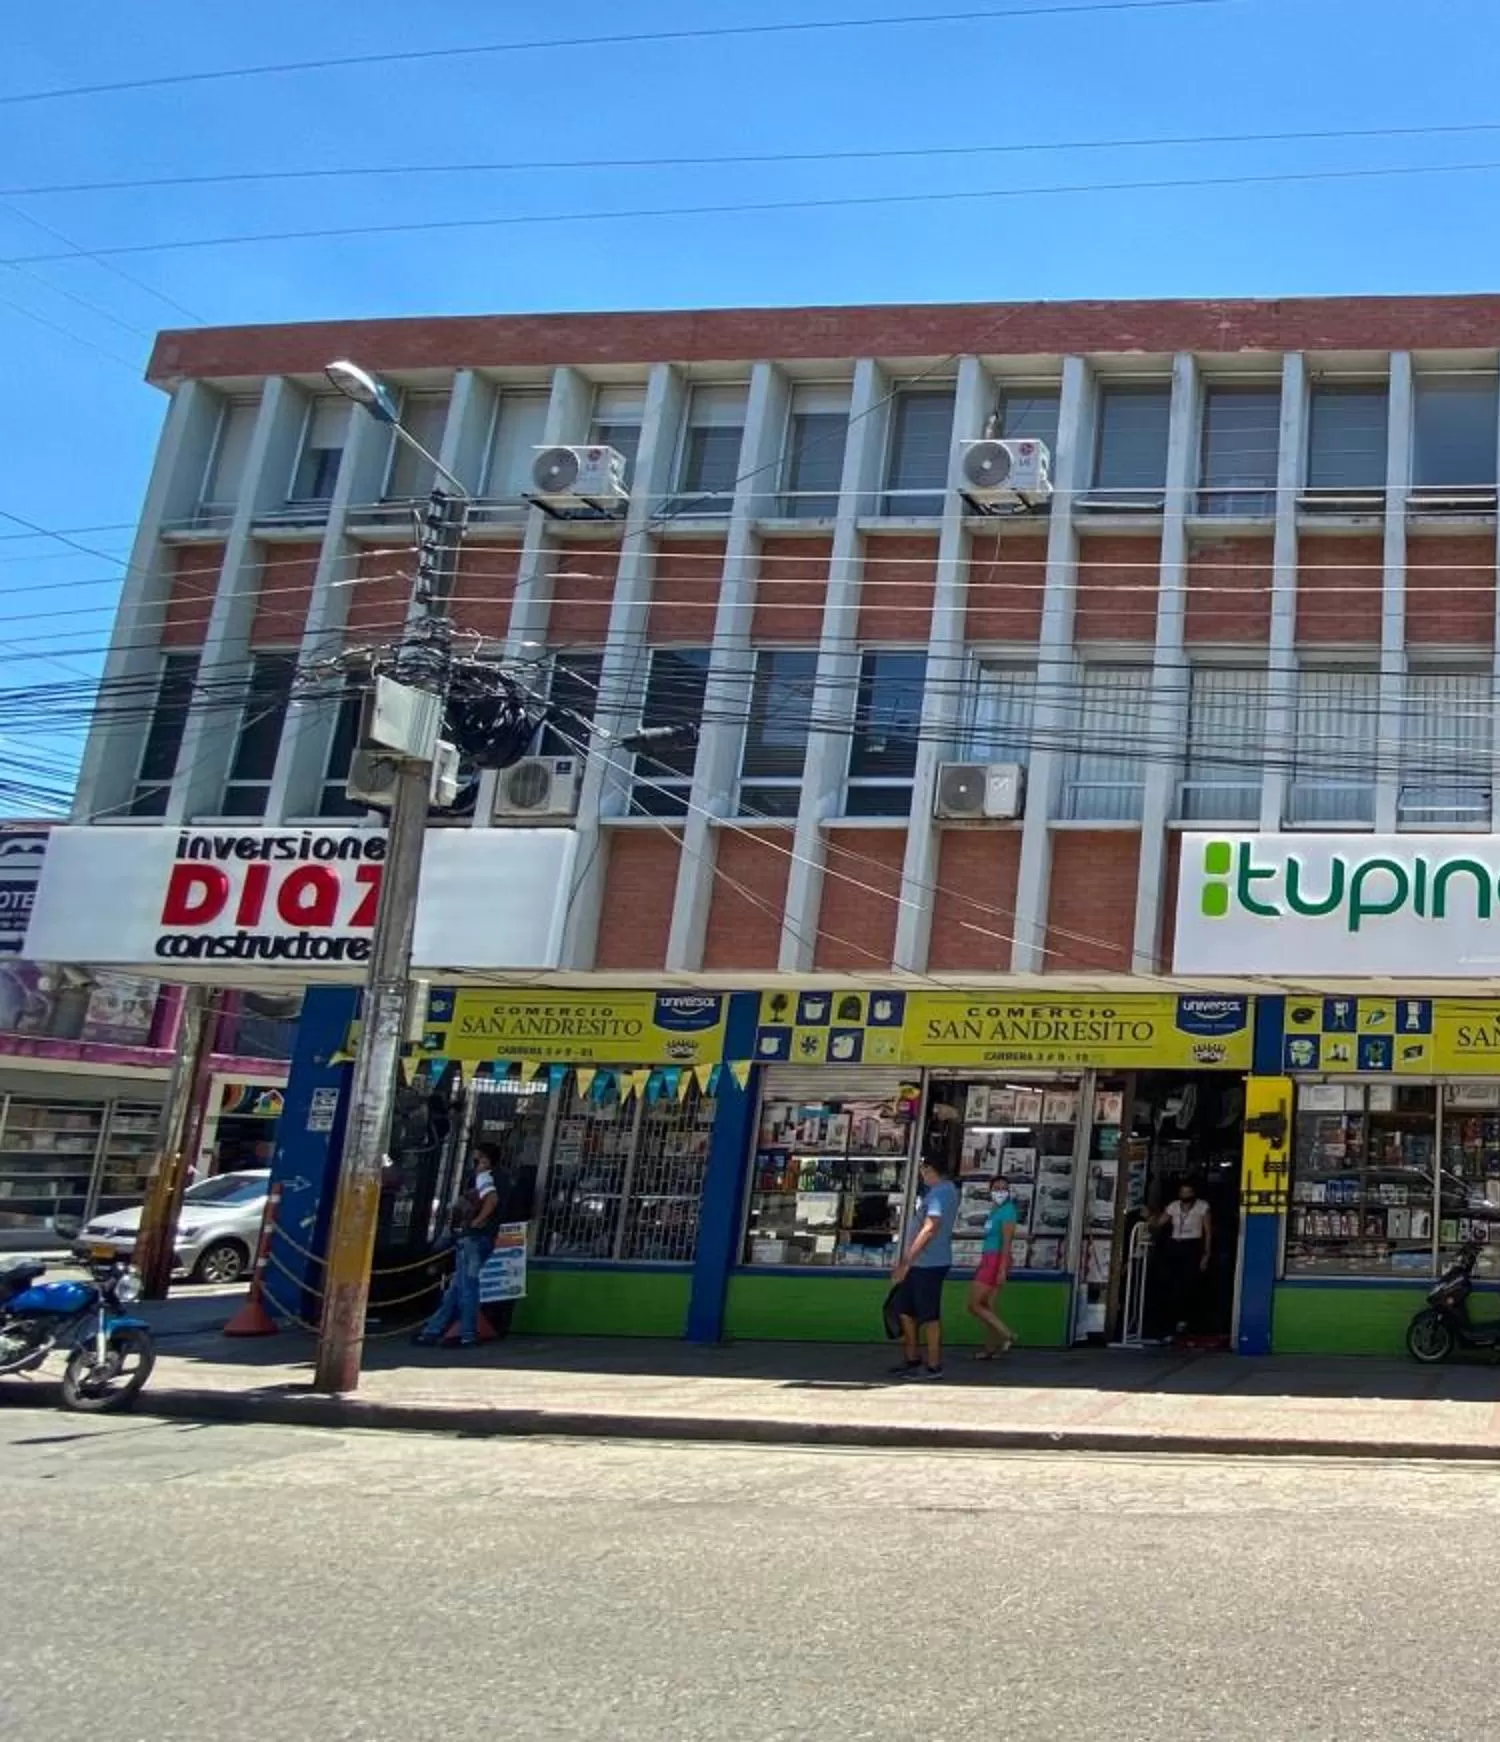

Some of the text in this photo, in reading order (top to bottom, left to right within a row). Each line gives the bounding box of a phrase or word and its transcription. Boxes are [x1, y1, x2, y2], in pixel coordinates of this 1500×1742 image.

[175, 830, 387, 861] inversione
[155, 931, 373, 960] constructore
[493, 1006, 613, 1017] COMERCIO
[967, 1007, 1117, 1018] COMERCIO
[460, 1015, 643, 1037] SAN ANDRESITO
[927, 1019, 1154, 1042] SAN ANDRESITO
